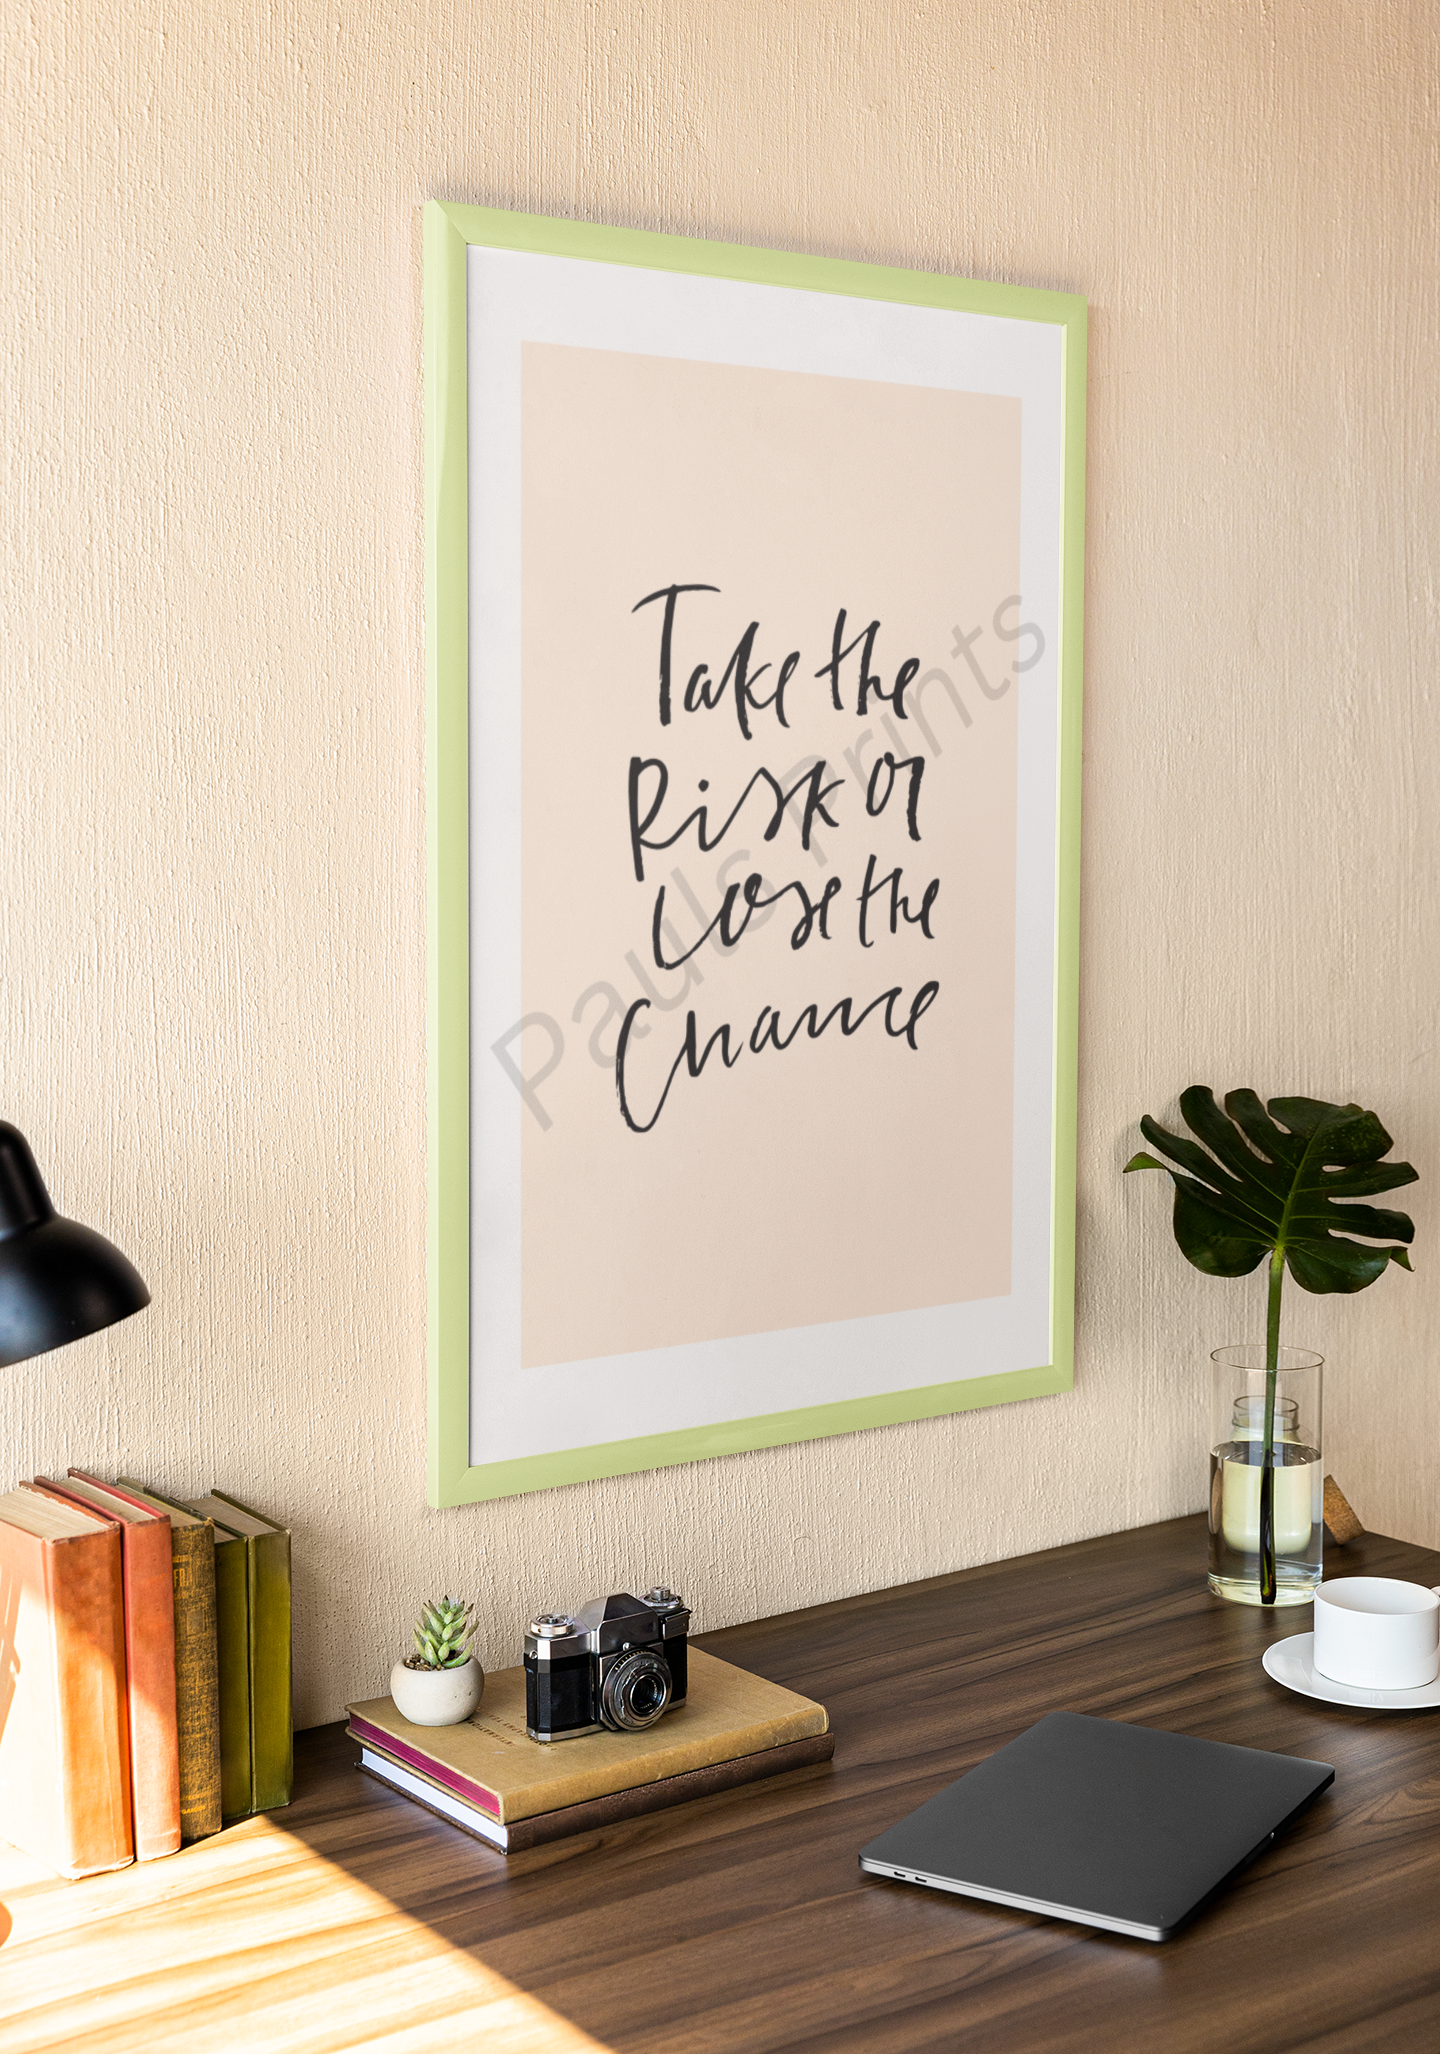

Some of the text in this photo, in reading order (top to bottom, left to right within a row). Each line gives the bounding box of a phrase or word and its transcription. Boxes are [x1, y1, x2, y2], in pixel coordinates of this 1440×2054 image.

[631, 584, 921, 741] Take the
[628, 751, 926, 882] Risk or
[652, 854, 940, 971] Lose the
[615, 980, 940, 1133] Chance
